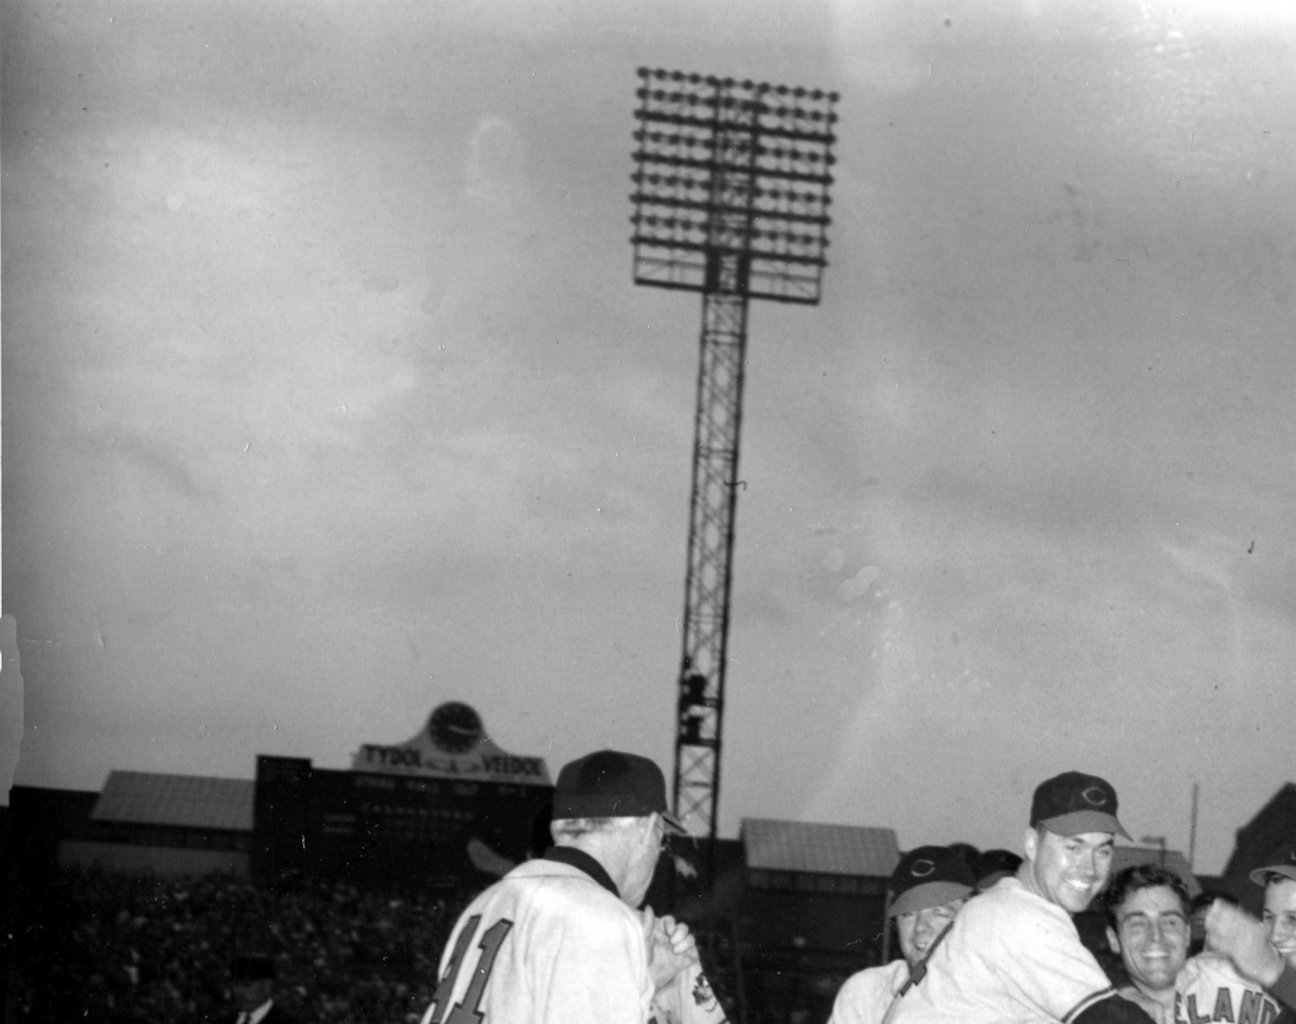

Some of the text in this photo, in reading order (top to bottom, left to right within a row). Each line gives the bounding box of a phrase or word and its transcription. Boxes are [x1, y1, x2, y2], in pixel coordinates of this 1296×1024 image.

[361, 743, 421, 769] TYDOL
[1081, 785, 1107, 806] C
[909, 858, 936, 878] C
